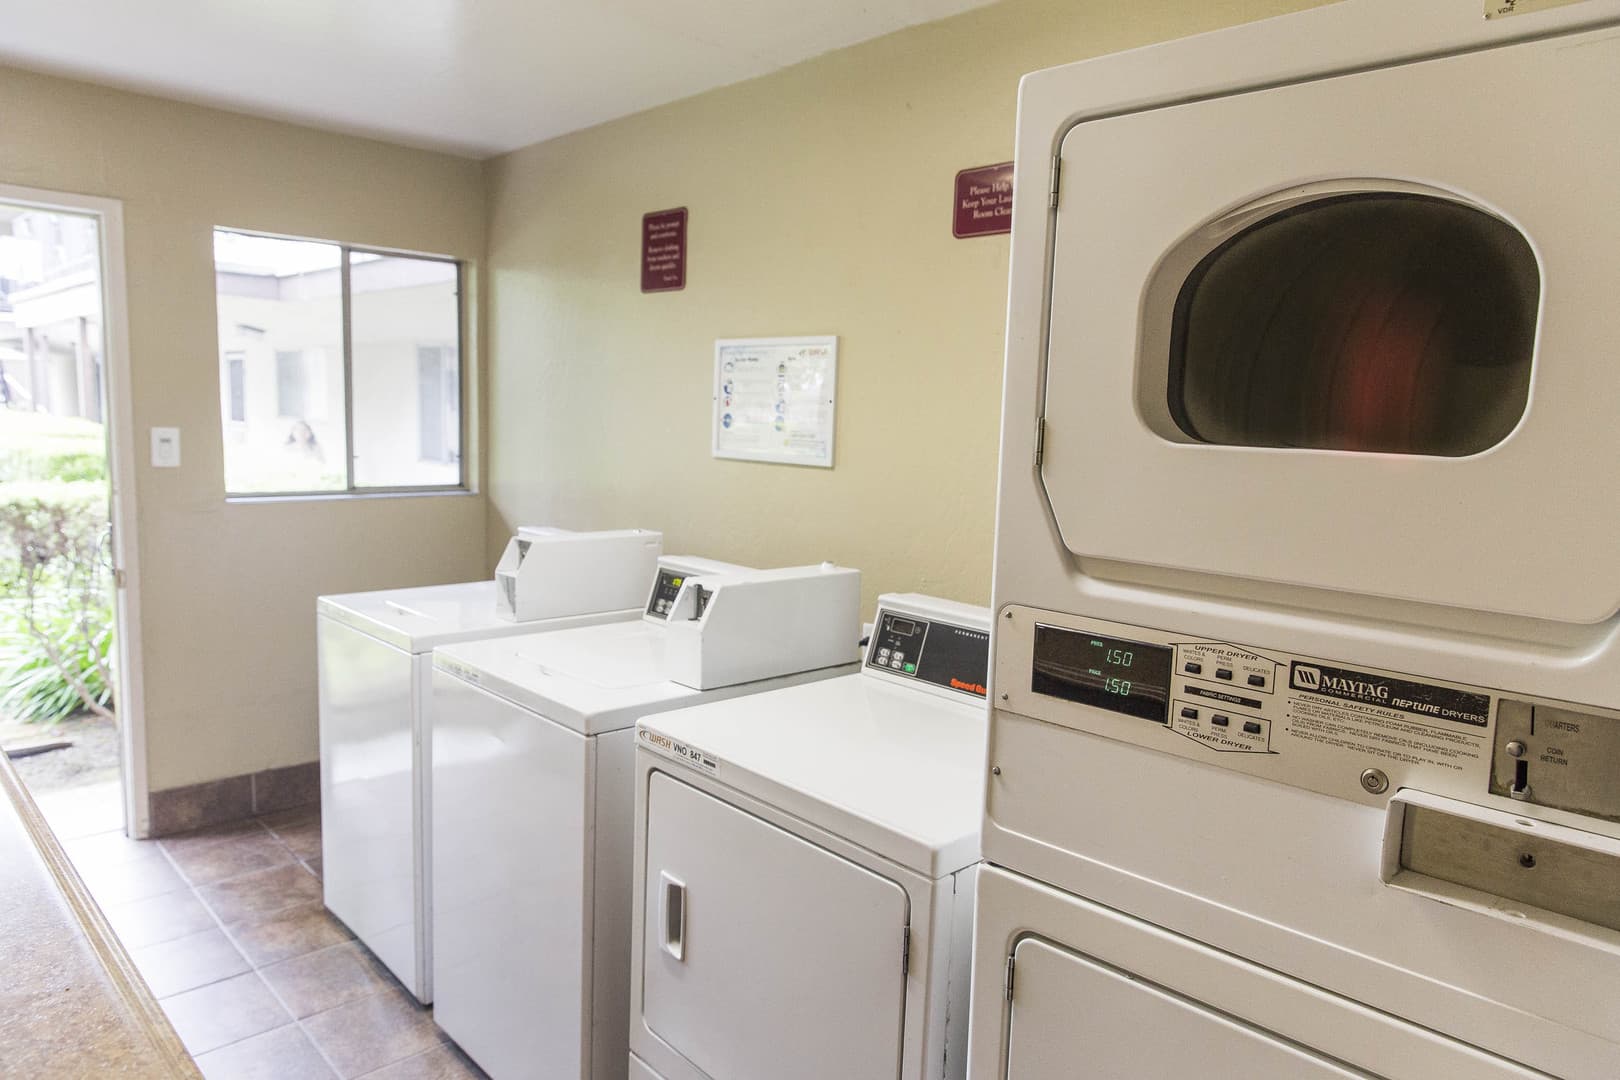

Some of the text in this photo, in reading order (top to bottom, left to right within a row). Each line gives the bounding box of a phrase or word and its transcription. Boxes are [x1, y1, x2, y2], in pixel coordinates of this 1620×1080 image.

[970, 186, 991, 196] Please
[962, 199, 980, 209] Keep
[981, 196, 998, 206] Your
[973, 208, 994, 219] Room
[1106, 649, 1133, 667] 1.50
[1184, 654, 1204, 662] COLORS
[1195, 645, 1258, 661] UPPER DRYER
[1216, 660, 1233, 668] PRESS
[1243, 665, 1270, 675] DELICATES
[950, 677, 976, 692] Speed
[1104, 678, 1131, 696] 1.50
[1322, 675, 1389, 699] MAYTAG
[1218, 693, 1241, 703] SETTINGS
[1321, 687, 1387, 704] COMMERCIAL
[1299, 694, 1404, 719] PERSONAL SAFETY RULES
[1392, 698, 1485, 723] NEPTUNE DRYERS
[1178, 724, 1199, 732] COLORS
[1187, 731, 1252, 750] LOWER DRYER
[1210, 732, 1227, 740] PRESS
[1238, 731, 1265, 742] DELICATES
[649, 732, 672, 750] WASH
[673, 743, 688, 756] VNO
[1546, 747, 1563, 756] COIN
[1540, 754, 1568, 766] RETURN
